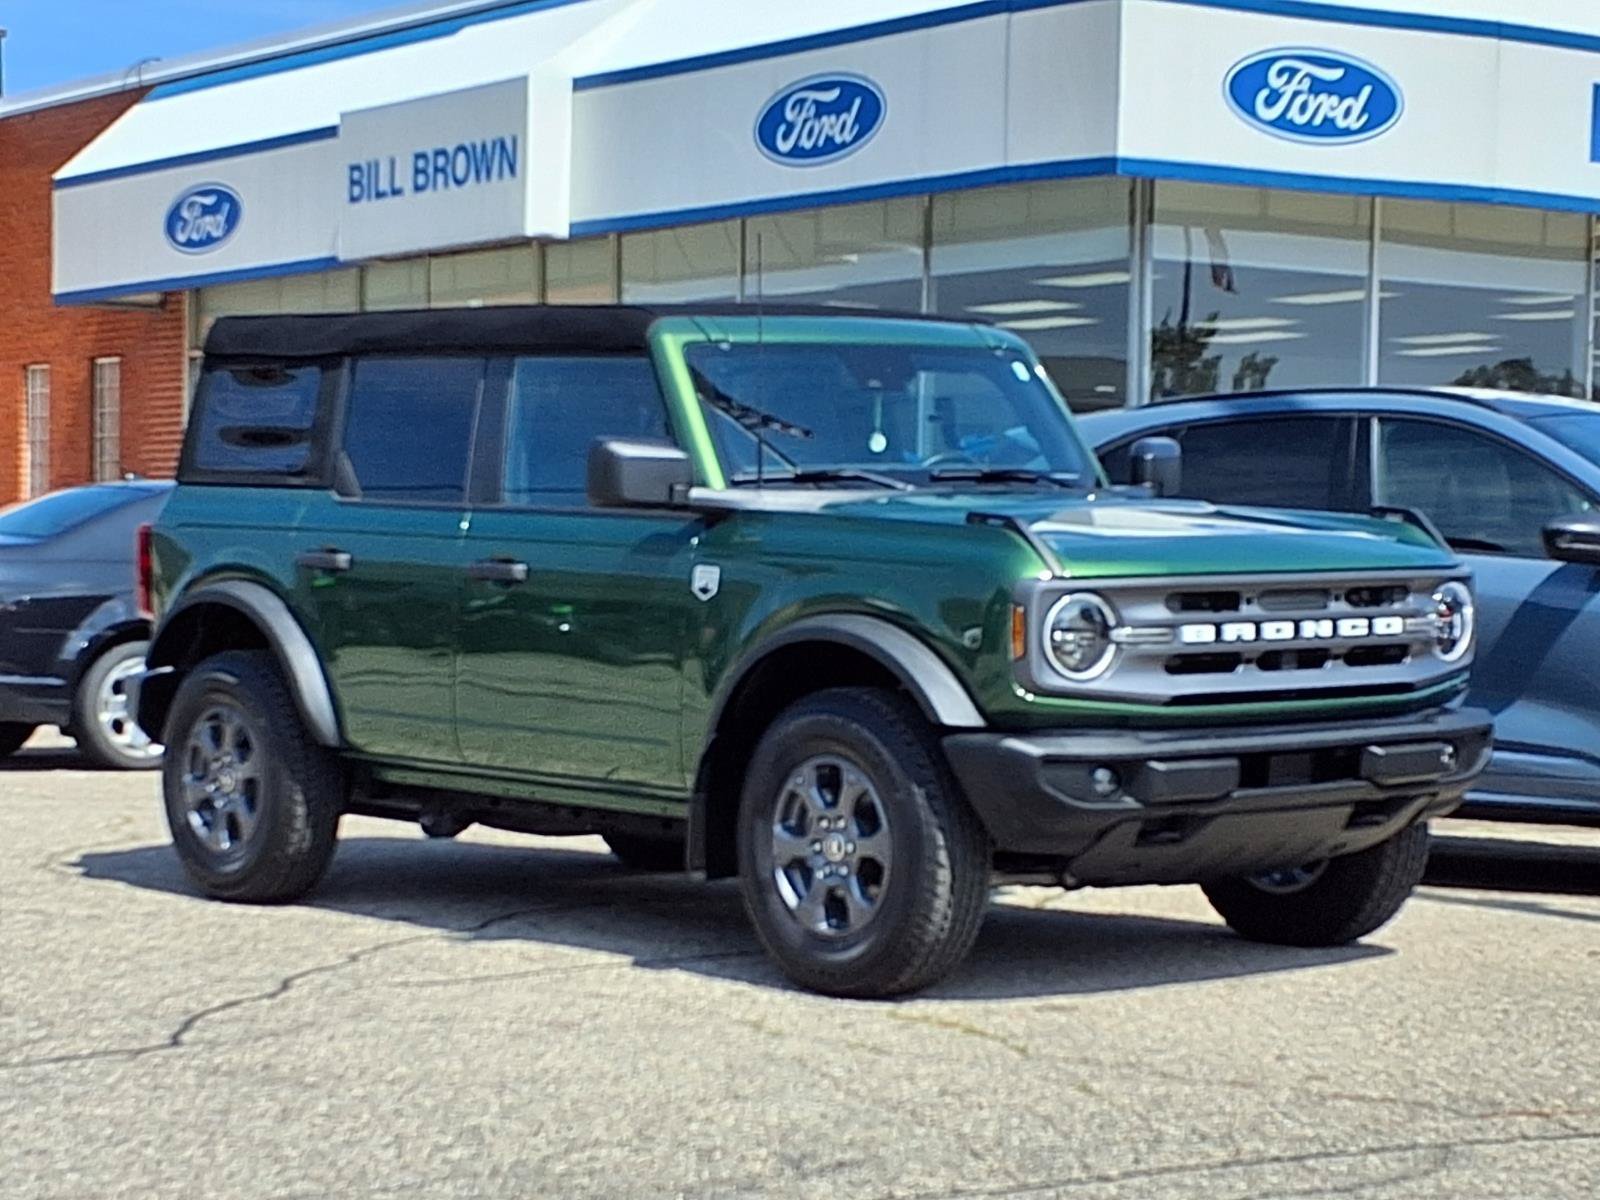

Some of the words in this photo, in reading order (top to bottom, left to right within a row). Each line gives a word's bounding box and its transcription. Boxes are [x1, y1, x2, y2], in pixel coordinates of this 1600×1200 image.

[776, 86, 862, 154] Ford
[1254, 58, 1373, 131] Ford
[348, 157, 404, 203] BILL
[413, 135, 518, 192] BROWN
[175, 194, 230, 243] Ford
[1180, 616, 1404, 643] BRONCO
